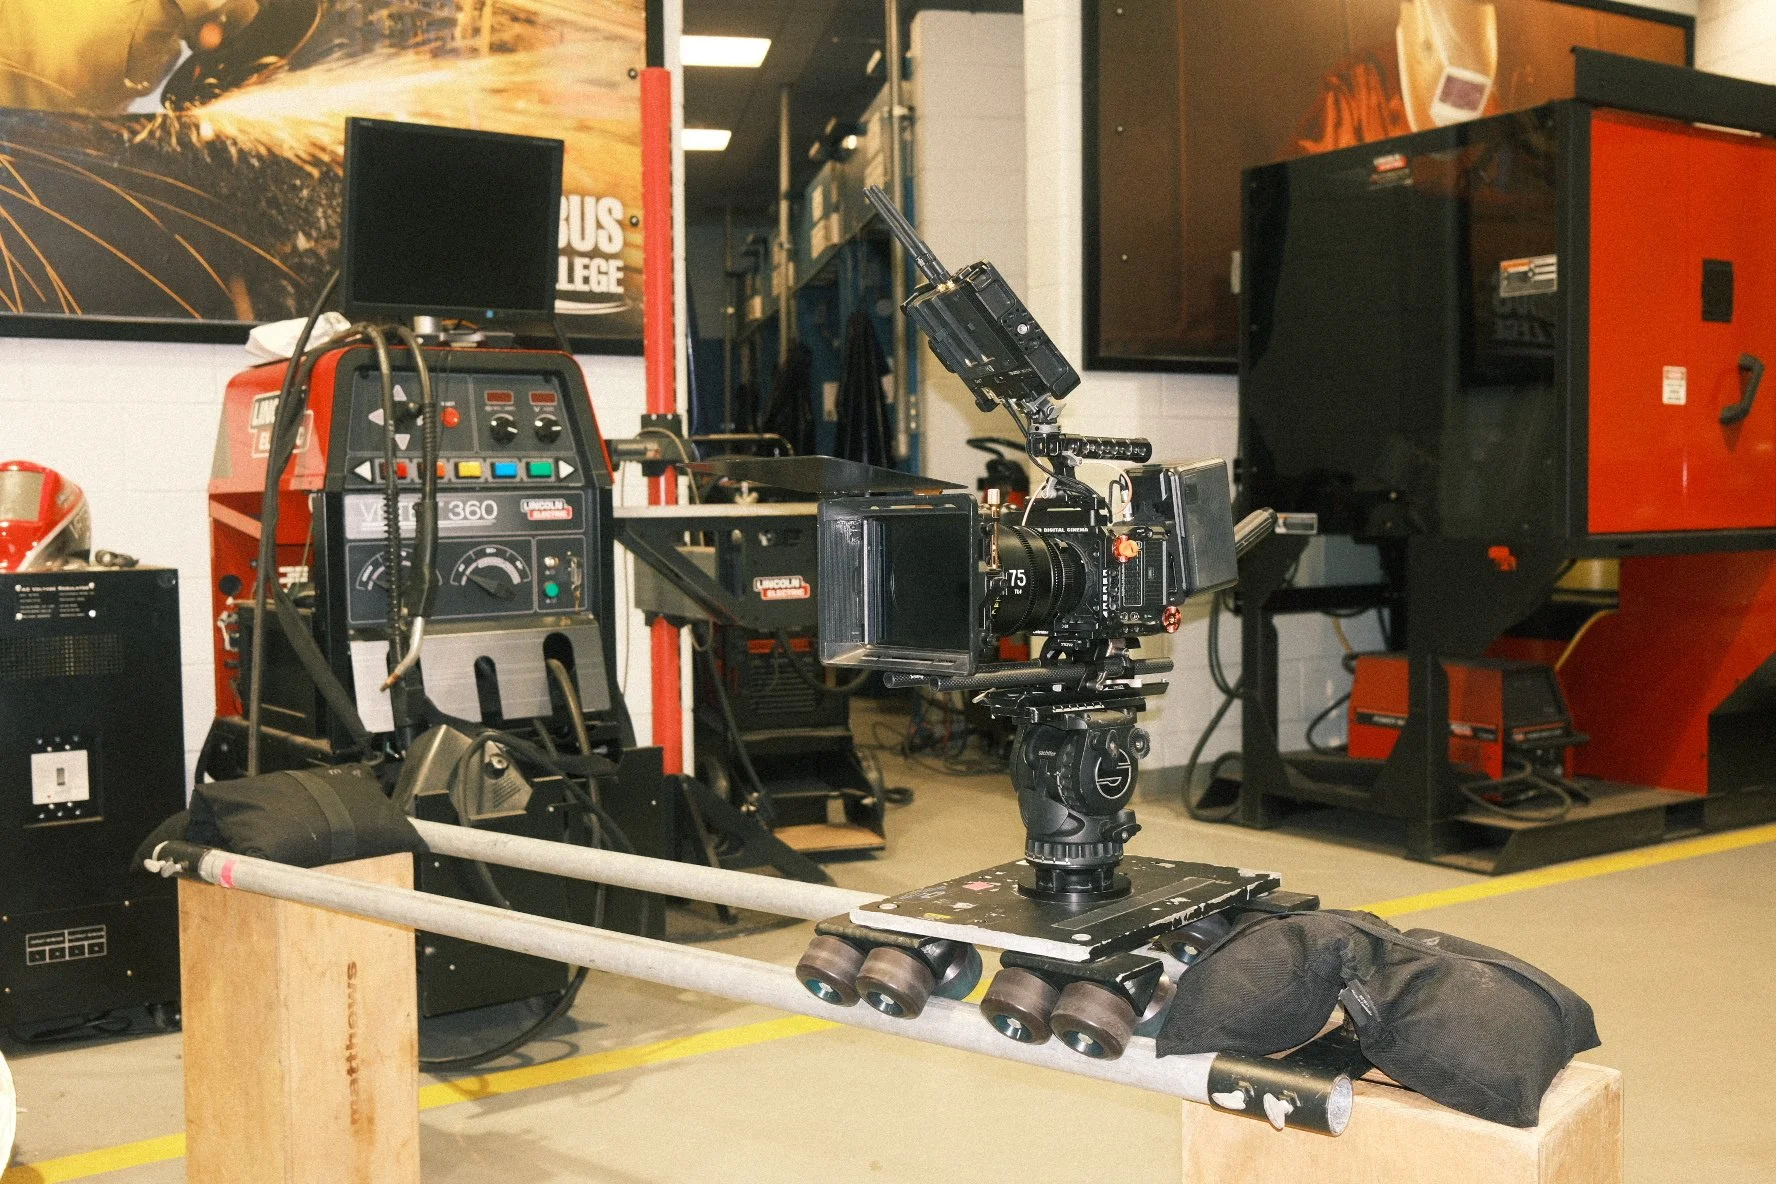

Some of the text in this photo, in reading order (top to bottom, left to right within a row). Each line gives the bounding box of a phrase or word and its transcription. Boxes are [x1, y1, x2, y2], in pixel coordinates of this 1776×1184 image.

[555, 256, 624, 294] LEGE
[448, 500, 498, 521] 360
[523, 500, 564, 511] LINCOLN
[756, 578, 801, 589] LINCOLN
[1008, 569, 1027, 587] 75
